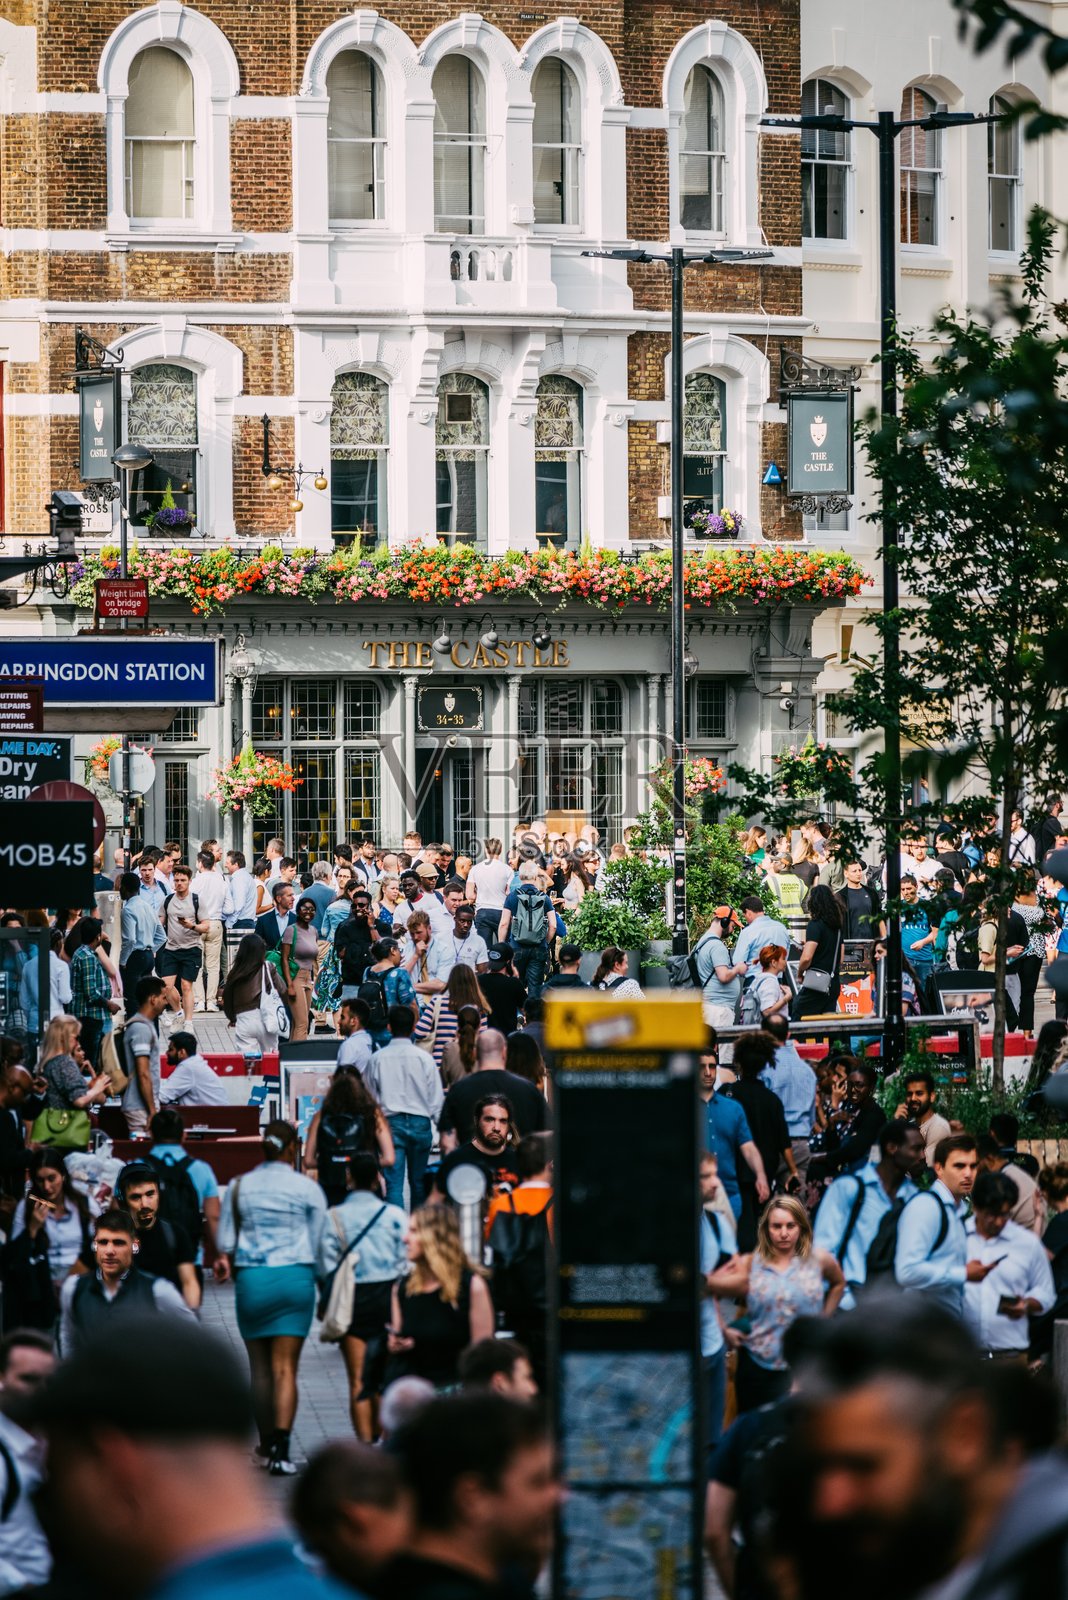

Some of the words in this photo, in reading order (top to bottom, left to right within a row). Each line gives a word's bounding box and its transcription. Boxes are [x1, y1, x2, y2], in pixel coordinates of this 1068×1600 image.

[93, 437, 104, 446] THE
[90, 448, 108, 458] CASTLE
[810, 451, 828, 461] THE
[803, 462, 834, 472] CASTLE
[80, 503, 109, 514] ROSS
[100, 588, 128, 599] Weight
[129, 589, 147, 598] limit
[117, 599, 142, 609] bridge
[108, 607, 119, 616] 20
[120, 608, 137, 616] tons
[362, 640, 435, 669] THE
[451, 639, 571, 669] CASTLE
[125, 663, 205, 681] STATION
[0, 712, 26, 720] AVING
[436, 714, 464, 726] 34-35
[0, 722, 35, 730] REPAIRS
[0, 741, 25, 755] ME
[0, 756, 38, 782] Dry
[0, 784, 40, 800] an
